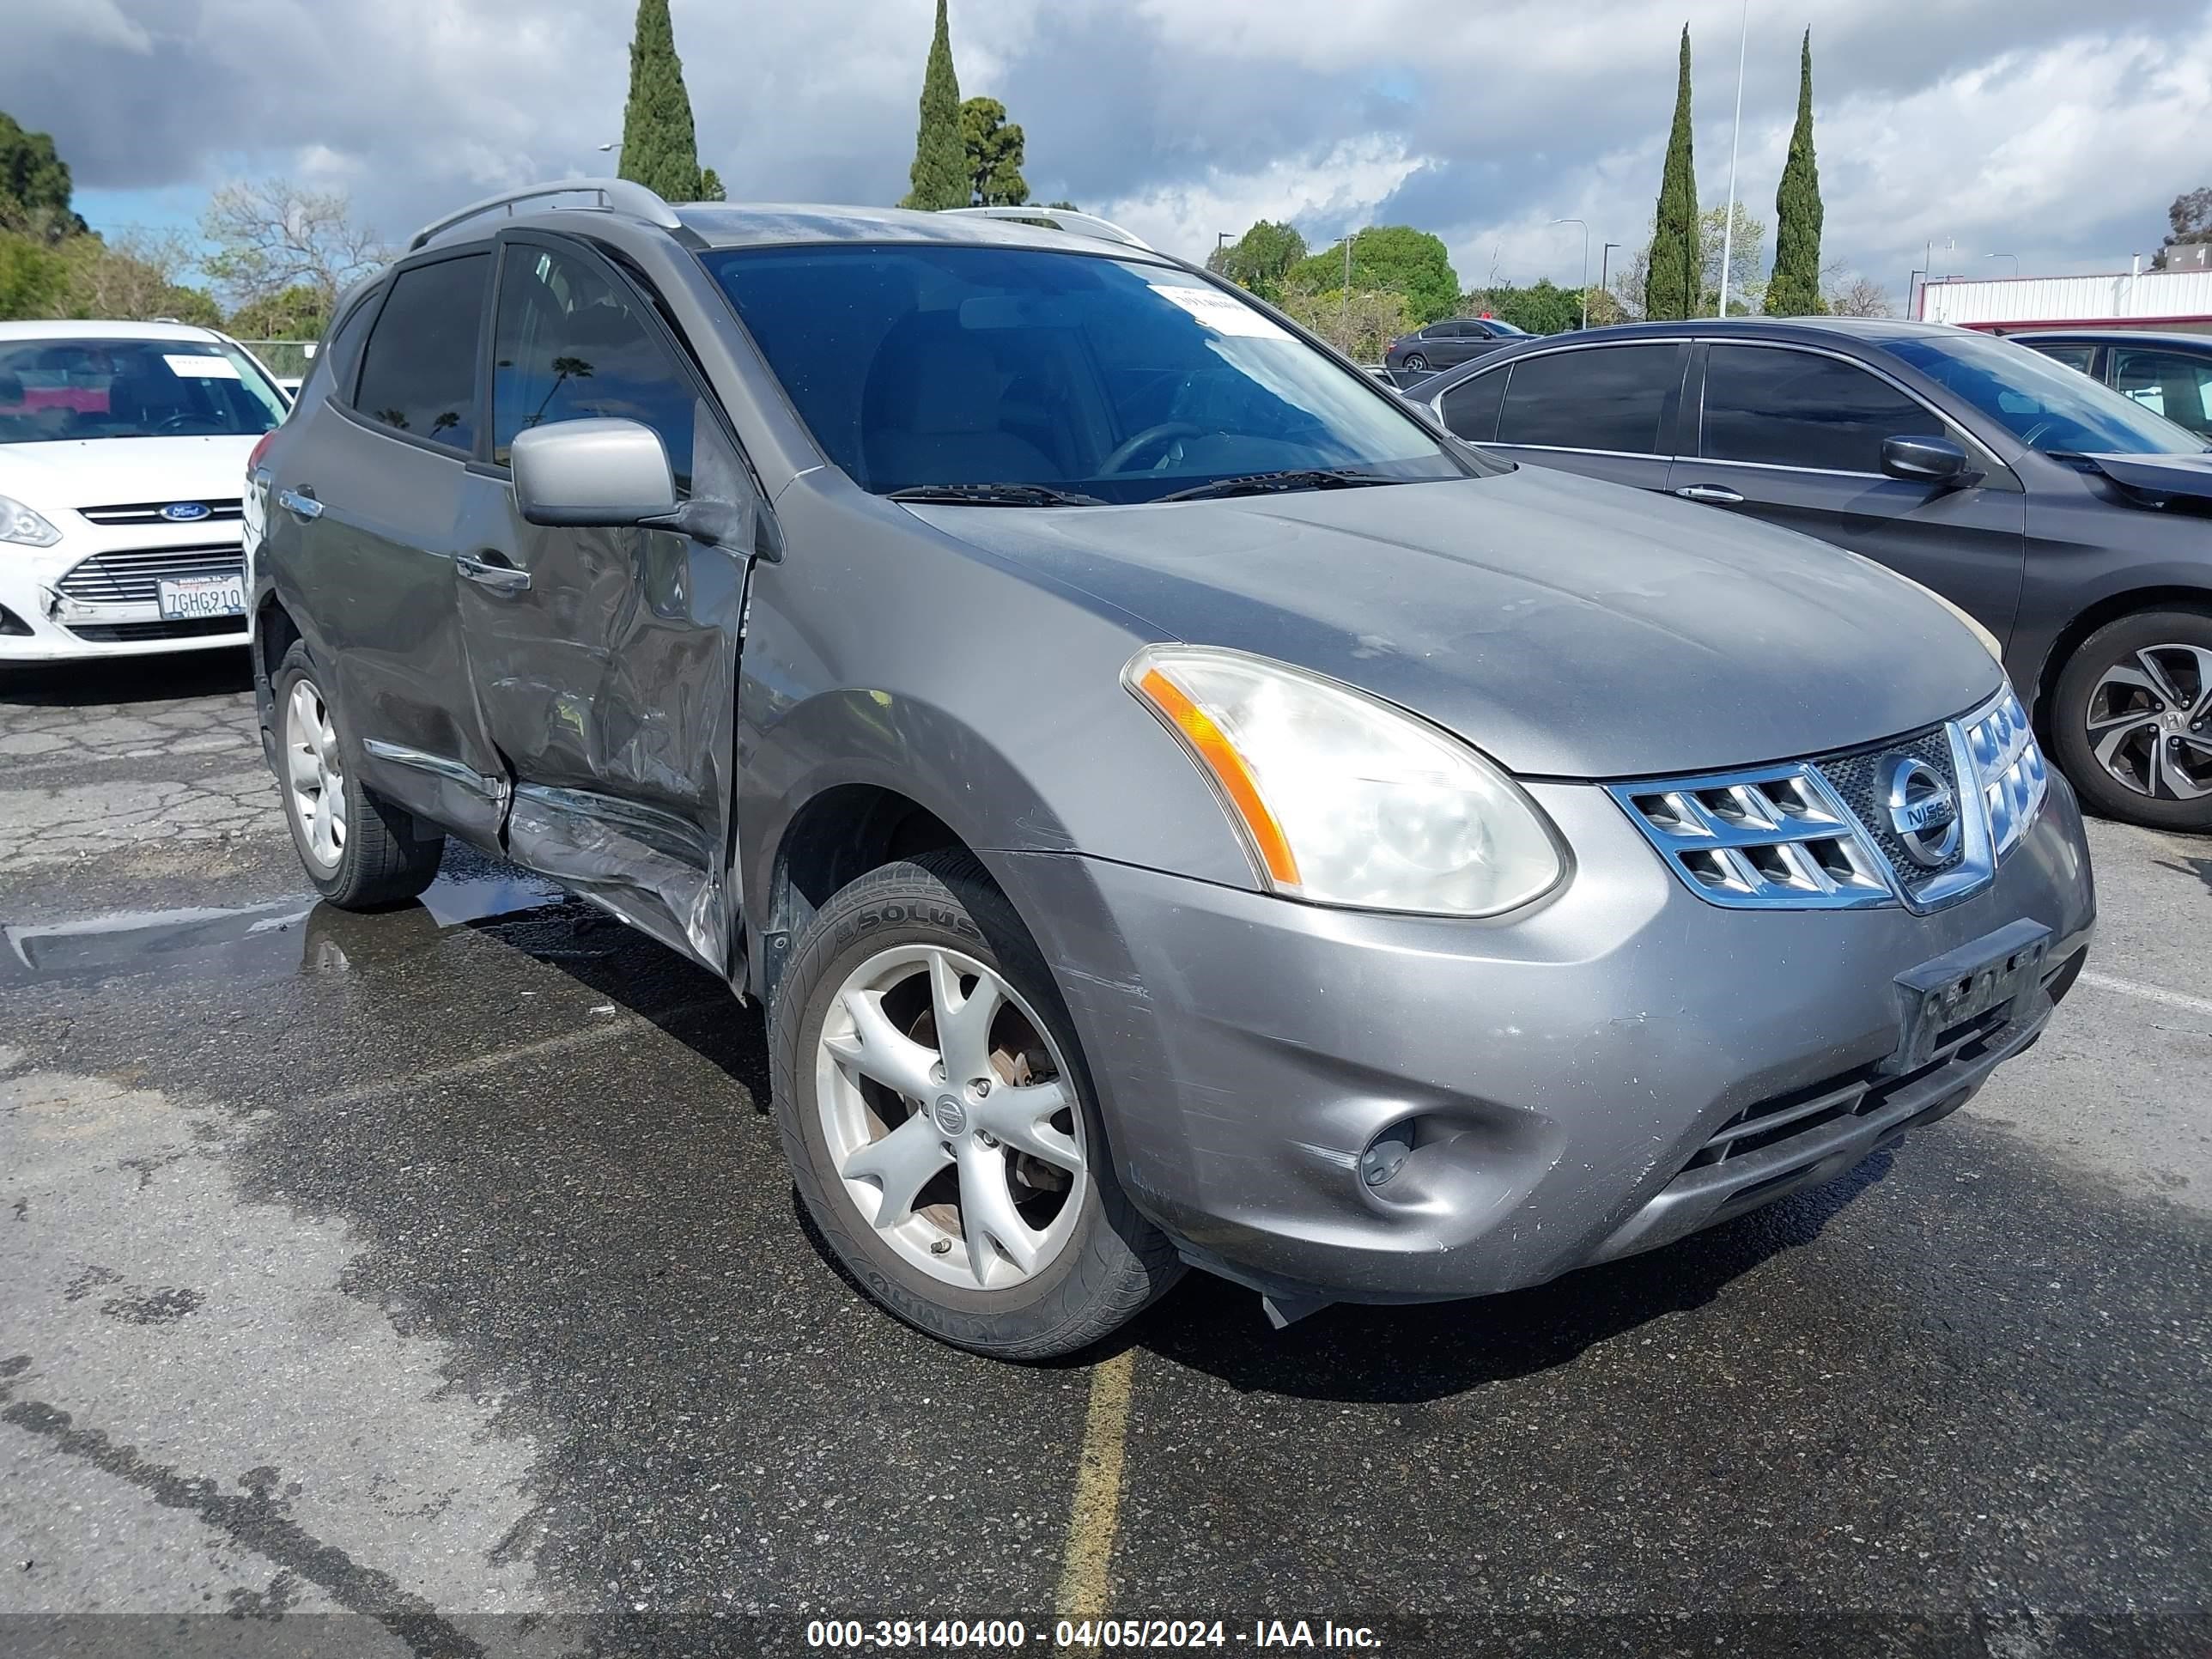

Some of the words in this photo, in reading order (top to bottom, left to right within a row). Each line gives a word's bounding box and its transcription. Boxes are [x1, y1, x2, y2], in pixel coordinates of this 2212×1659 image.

[172, 506, 199, 517] Ford
[167, 589, 240, 613] 7GHG910
[1906, 799, 1954, 826] NISSA
[857, 904, 981, 940] SOLUS
